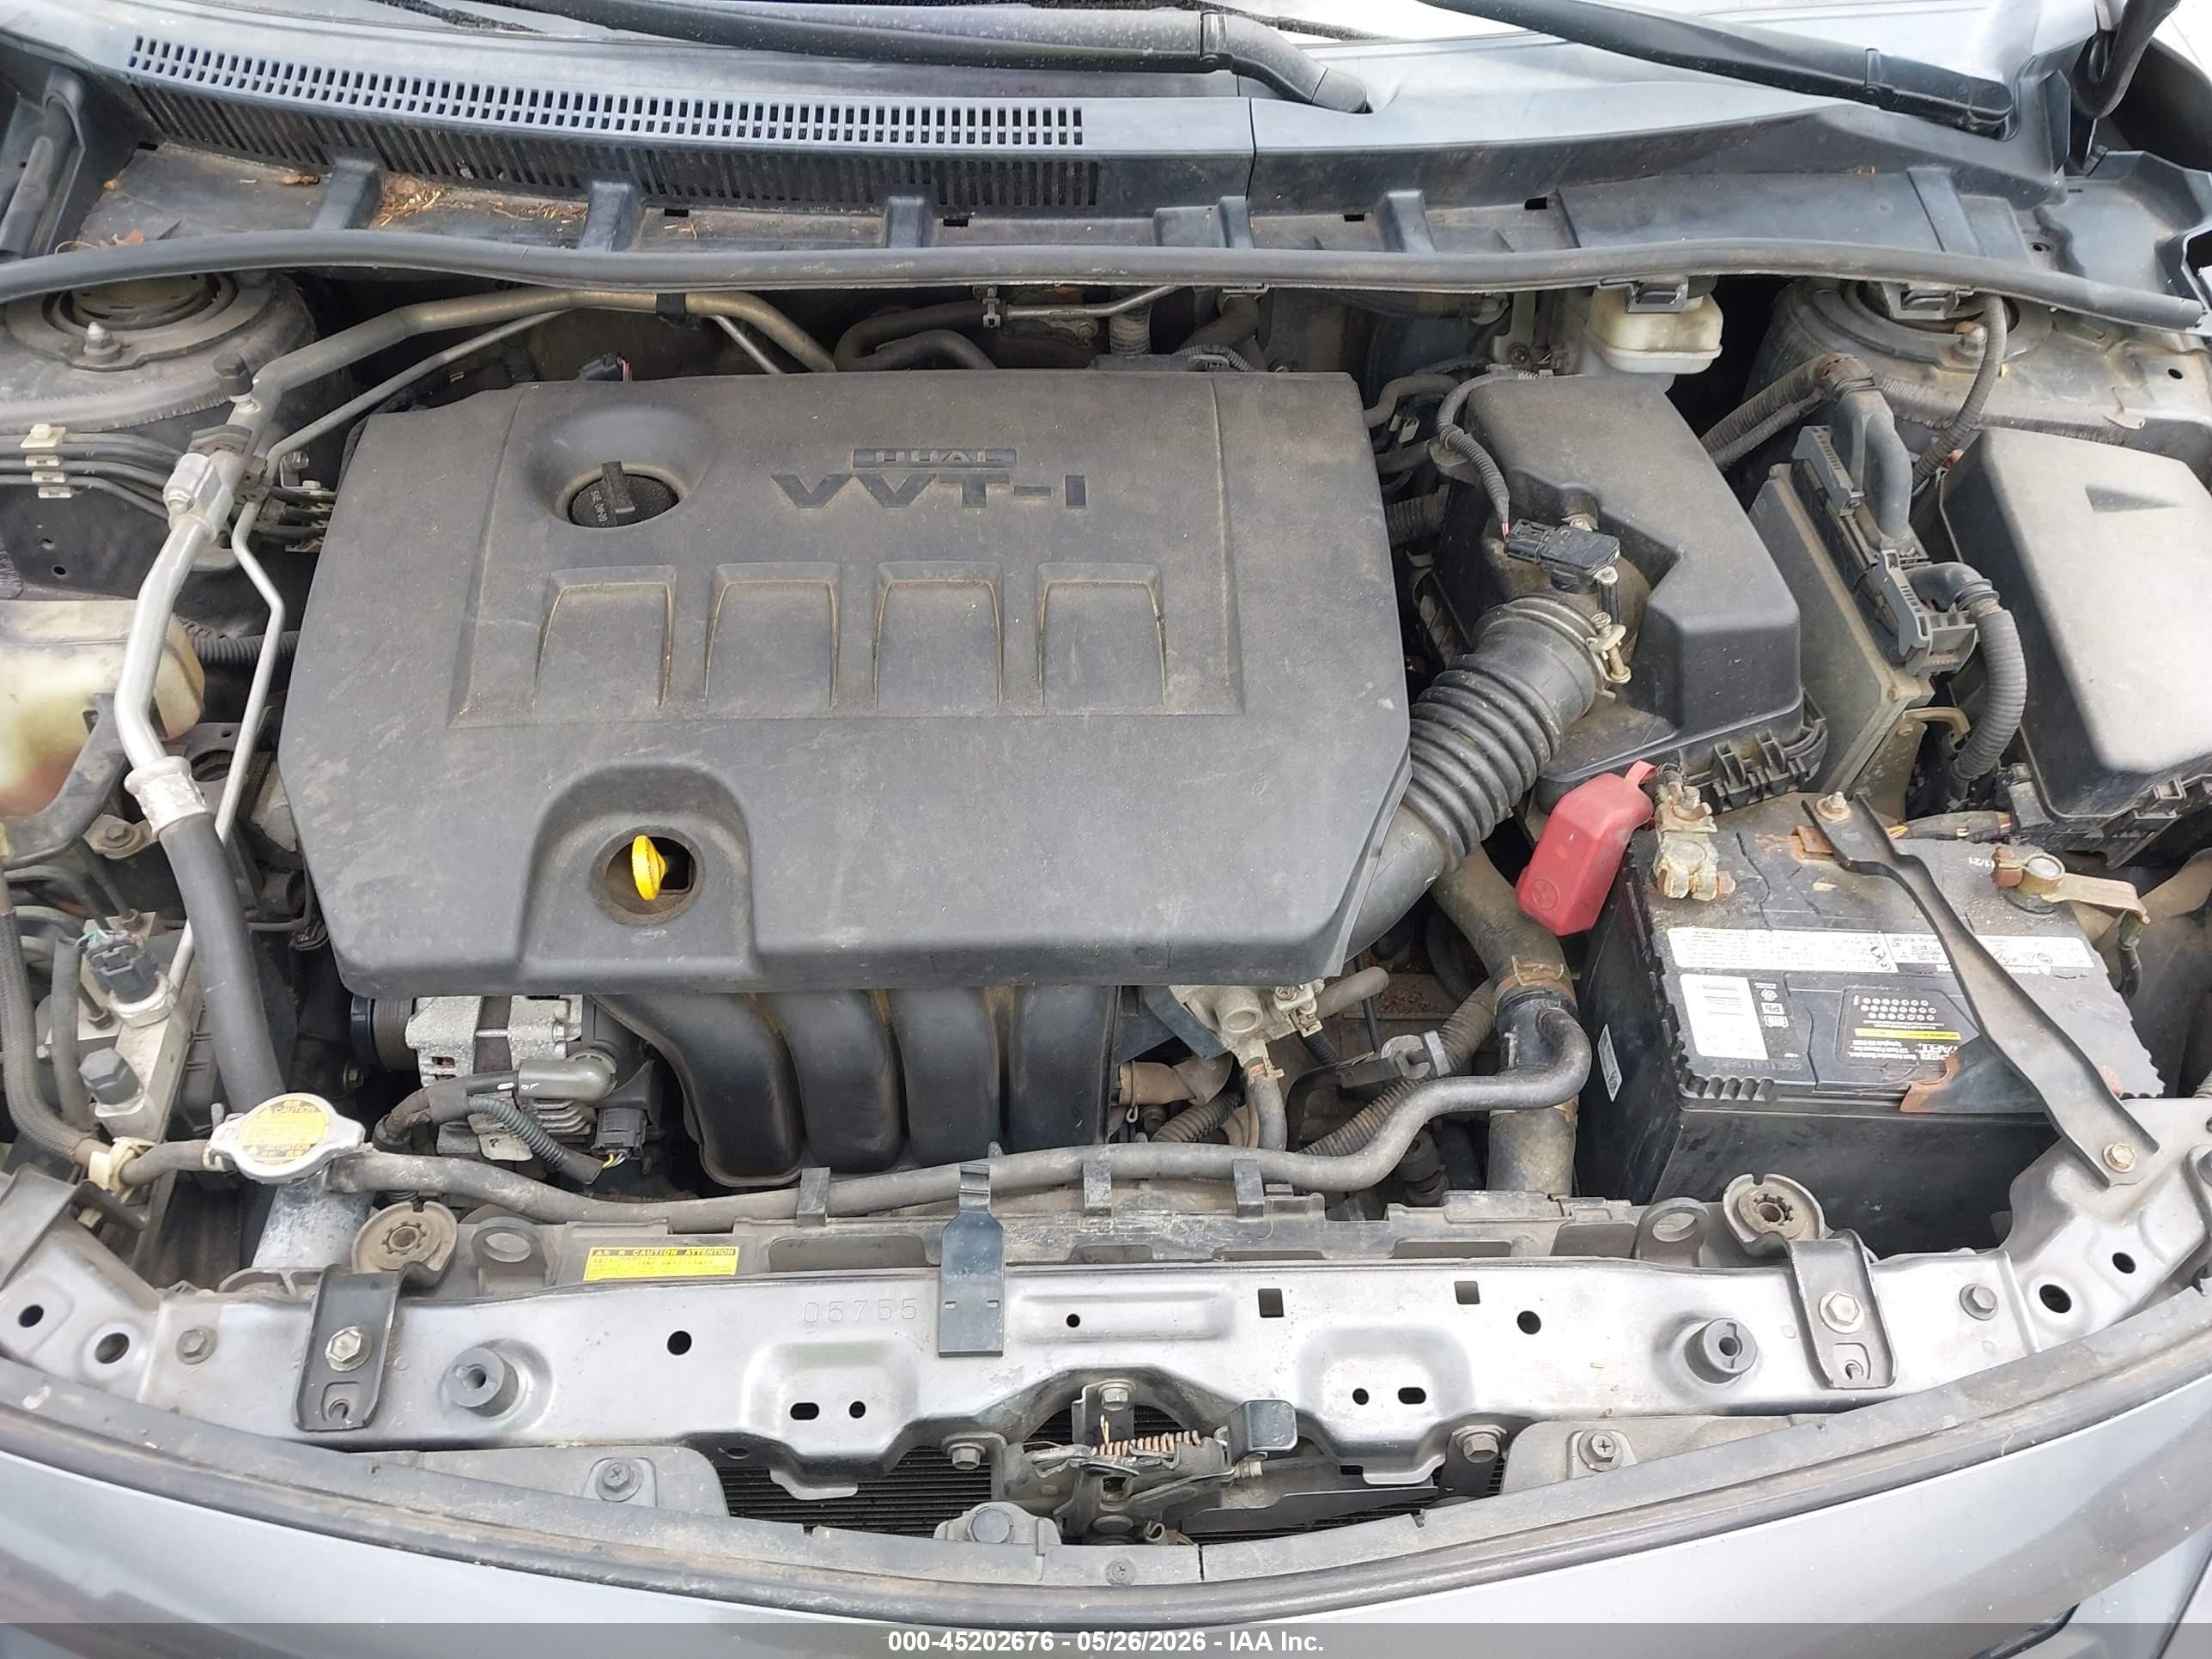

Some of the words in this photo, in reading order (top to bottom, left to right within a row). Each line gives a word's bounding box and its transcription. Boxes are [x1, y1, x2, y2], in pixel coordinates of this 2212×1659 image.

[875, 449, 1003, 462] DUAL
[1765, 1004, 1781, 1012] Pb
[275, 1105, 318, 1114] CAUTION
[804, 1297, 917, 1323] 05755
